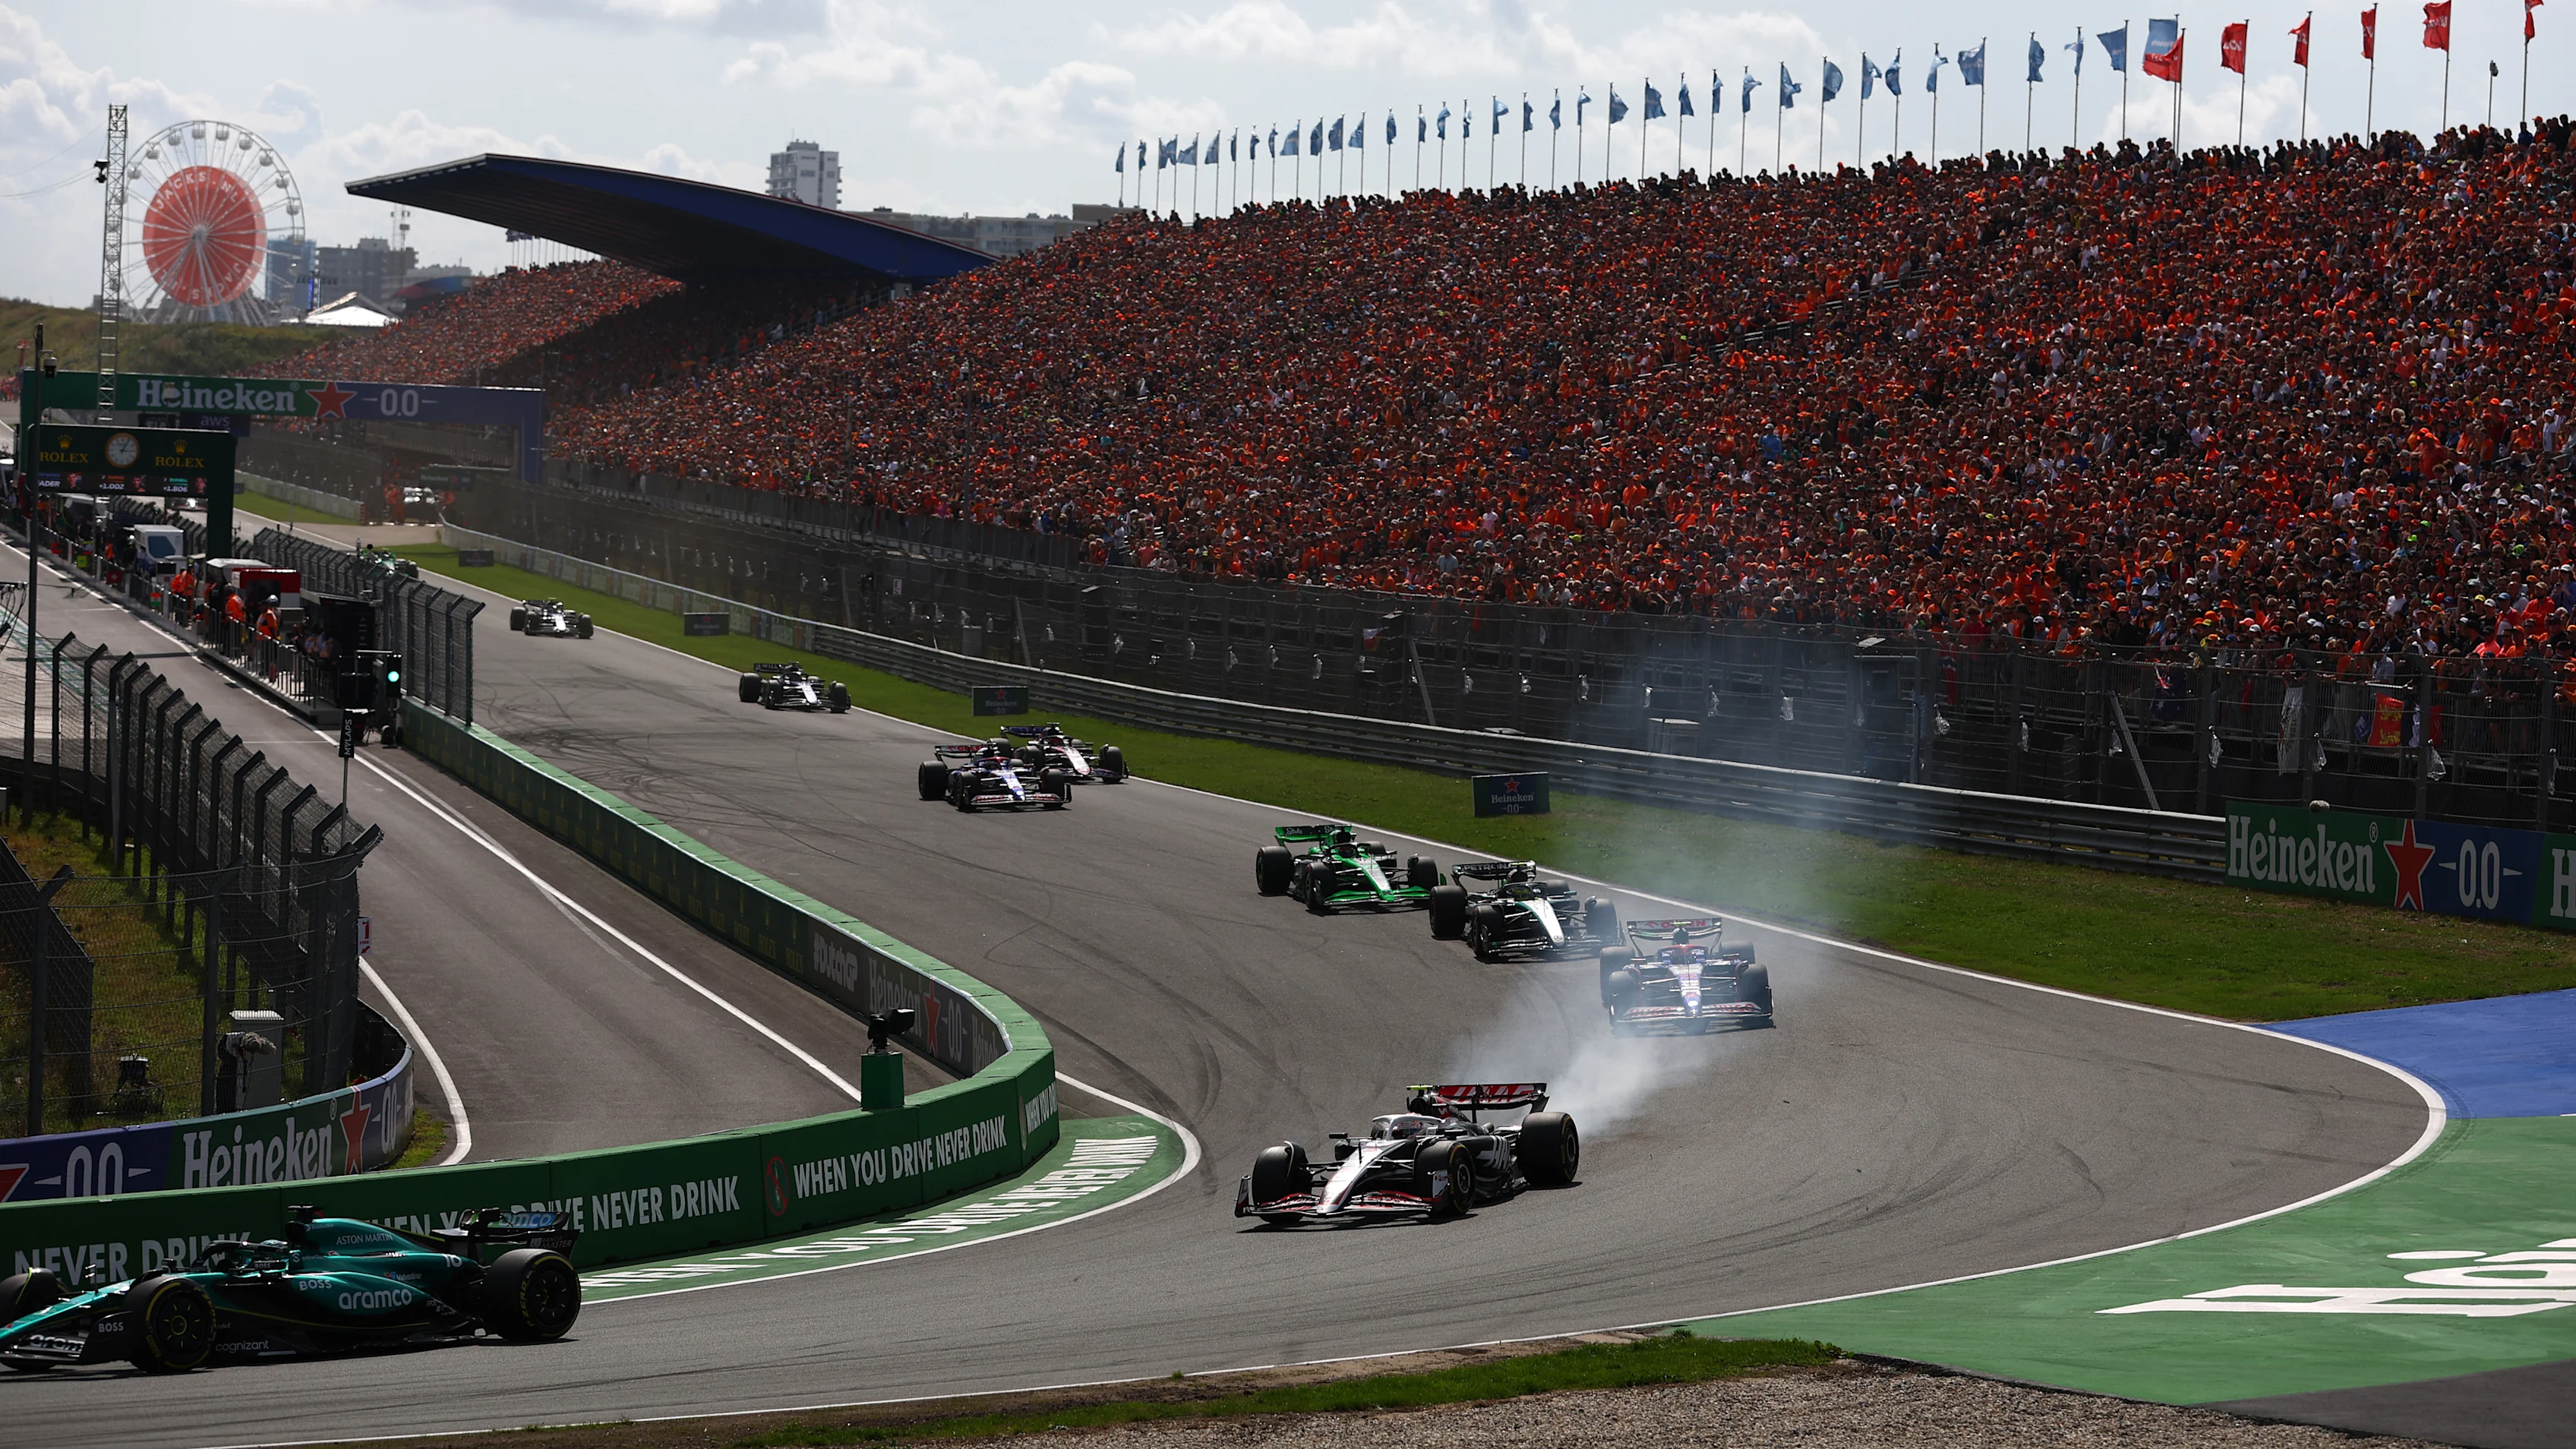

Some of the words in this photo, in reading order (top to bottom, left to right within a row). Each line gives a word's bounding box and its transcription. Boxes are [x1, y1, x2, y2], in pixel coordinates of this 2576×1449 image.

[380, 389, 418, 417] 0.0
[200, 415, 230, 427] aws
[39, 452, 90, 463] ROLEX
[155, 456, 206, 468] ROLEX
[344, 718, 352, 756] MYLAPS
[1491, 794, 1535, 804] Heineken
[2226, 814, 2376, 895] Heineken
[2459, 838, 2502, 911] 0.0
[813, 932, 858, 993] #DutchGP
[948, 998, 963, 1063] 0.0
[183, 1116, 333, 1189] Heineken
[793, 1157, 848, 1200] WHEN
[850, 1148, 887, 1188] YOU
[891, 1137, 934, 1179] DRIVE
[935, 1127, 972, 1166] NEVER
[972, 1114, 1008, 1156] DRINK
[988, 1166, 1141, 1200] NEVER
[592, 1186, 665, 1232] NEVER
[670, 1175, 741, 1220] DRINK
[336, 1234, 364, 1245] ASTON
[365, 1233, 393, 1243] MARTIN
[541, 1239, 573, 1249] MASTER
[298, 1279, 333, 1291] BOSS
[396, 1273, 423, 1281] Valvoline
[338, 1289, 412, 1310] aramco
[98, 1321, 125, 1334] BOSS
[30, 1334, 85, 1353] aram
[215, 1339, 277, 1355] cognizant
